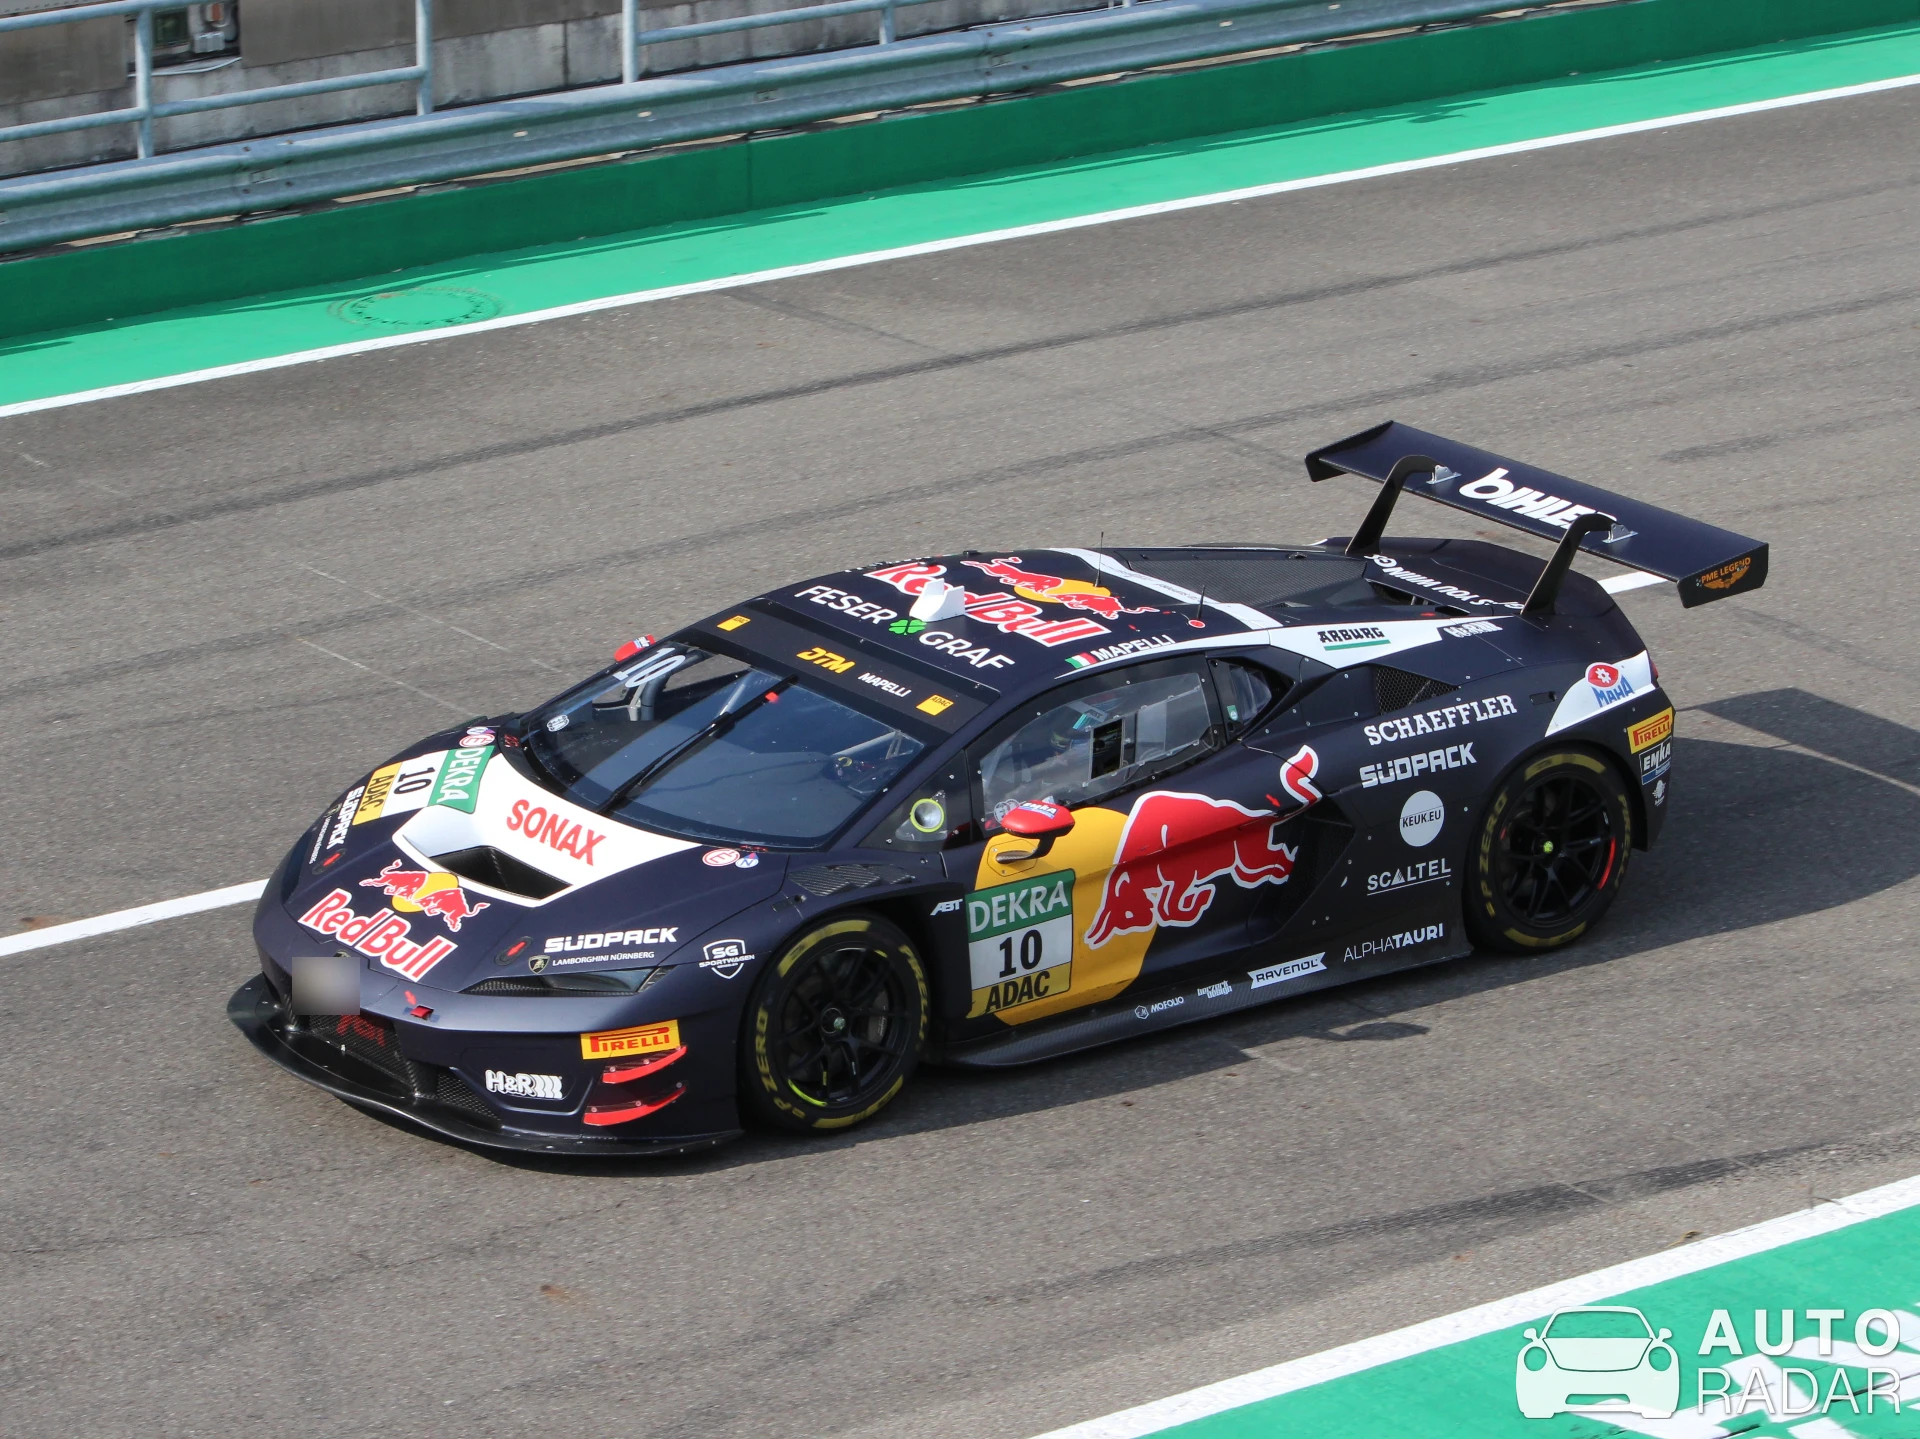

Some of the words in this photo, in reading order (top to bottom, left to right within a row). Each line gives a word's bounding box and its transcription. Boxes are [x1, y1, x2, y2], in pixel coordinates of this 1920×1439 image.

[1459, 467, 1617, 536] bIHLE
[1701, 570, 1718, 583] PME
[1720, 557, 1751, 576] LEGEND
[1431, 585, 1480, 601] YOU
[794, 585, 898, 625] FESER
[919, 631, 1016, 670] GRAF
[963, 600, 1112, 647] Bull
[1317, 627, 1385, 643] ARBURG
[796, 647, 856, 674] DTM
[1090, 634, 1176, 661] MAPELLI
[612, 648, 686, 688] 10
[858, 672, 912, 698] MAPELLI
[1591, 674, 1635, 708] MAHA
[929, 695, 951, 707] ADAC
[1364, 694, 1518, 746] SCHAEFFLER
[1633, 714, 1670, 747] PIRELLI
[1359, 742, 1477, 788] SÜDPACK
[1643, 742, 1671, 771] EMKA
[394, 766, 436, 795] 10
[437, 747, 487, 804] DEKRA
[360, 774, 395, 812] ADAC
[506, 799, 608, 866] SONAX
[1402, 808, 1442, 829] KEUK.EU
[1367, 858, 1451, 892] SCALTEL
[930, 899, 963, 916] ABT
[969, 880, 1069, 934] DEKRA
[298, 888, 395, 947] Red
[354, 915, 459, 983] Bull
[544, 927, 679, 954] SÜDPACK
[1343, 923, 1444, 962] ALPHATAURI
[552, 953, 609, 966] LAMBORGHINI
[610, 951, 655, 961] NÜRNBERG
[699, 954, 755, 968] SPORTWAGEN
[712, 945, 739, 959] SG
[999, 929, 1043, 978] 10
[1256, 959, 1318, 983] RAVENOL
[985, 970, 1050, 1014] ADAC
[1150, 996, 1185, 1013] MOFOLIO
[590, 1026, 670, 1053] PIRELLI
[485, 1069, 548, 1098] H&R
